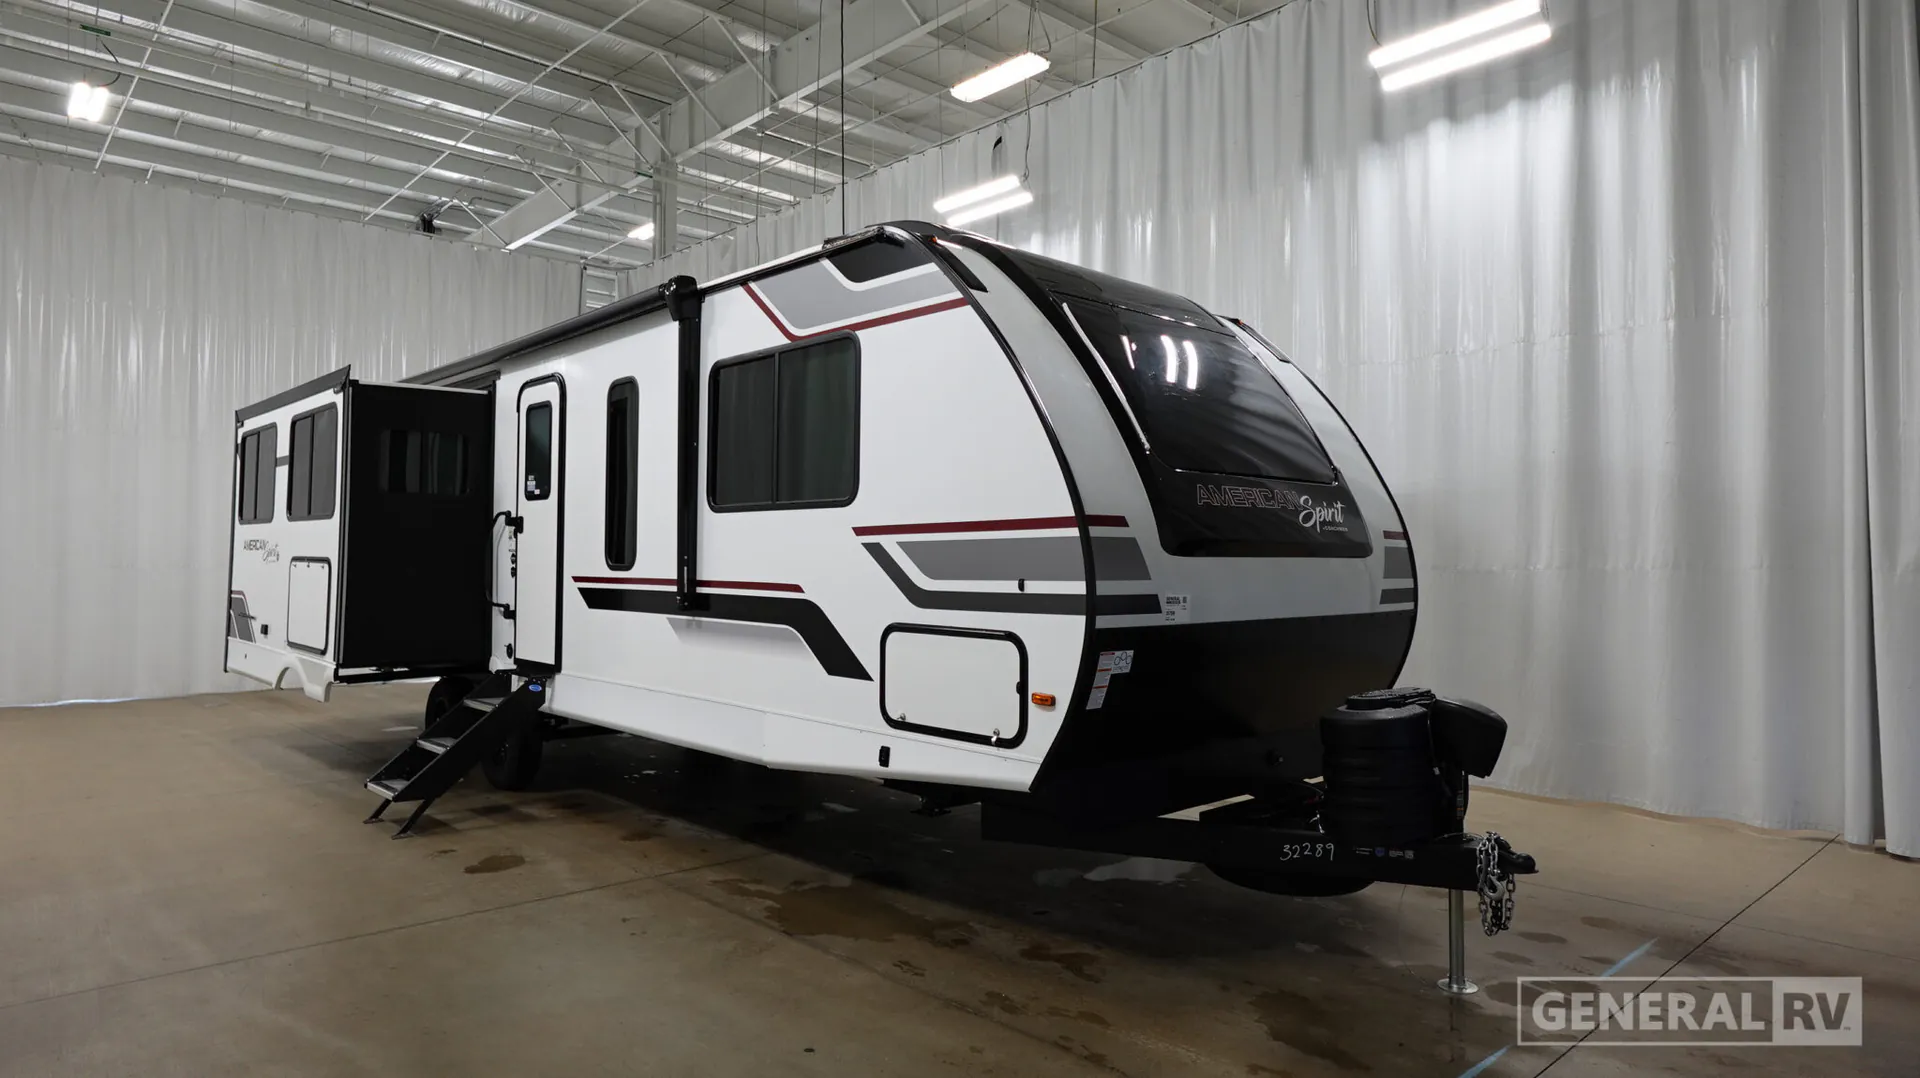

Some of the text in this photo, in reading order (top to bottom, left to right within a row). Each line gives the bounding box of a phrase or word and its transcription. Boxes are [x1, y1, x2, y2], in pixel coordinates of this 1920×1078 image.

[1196, 484, 1345, 533] AMERICAN Spirit
[1280, 842, 1335, 861] 32289
